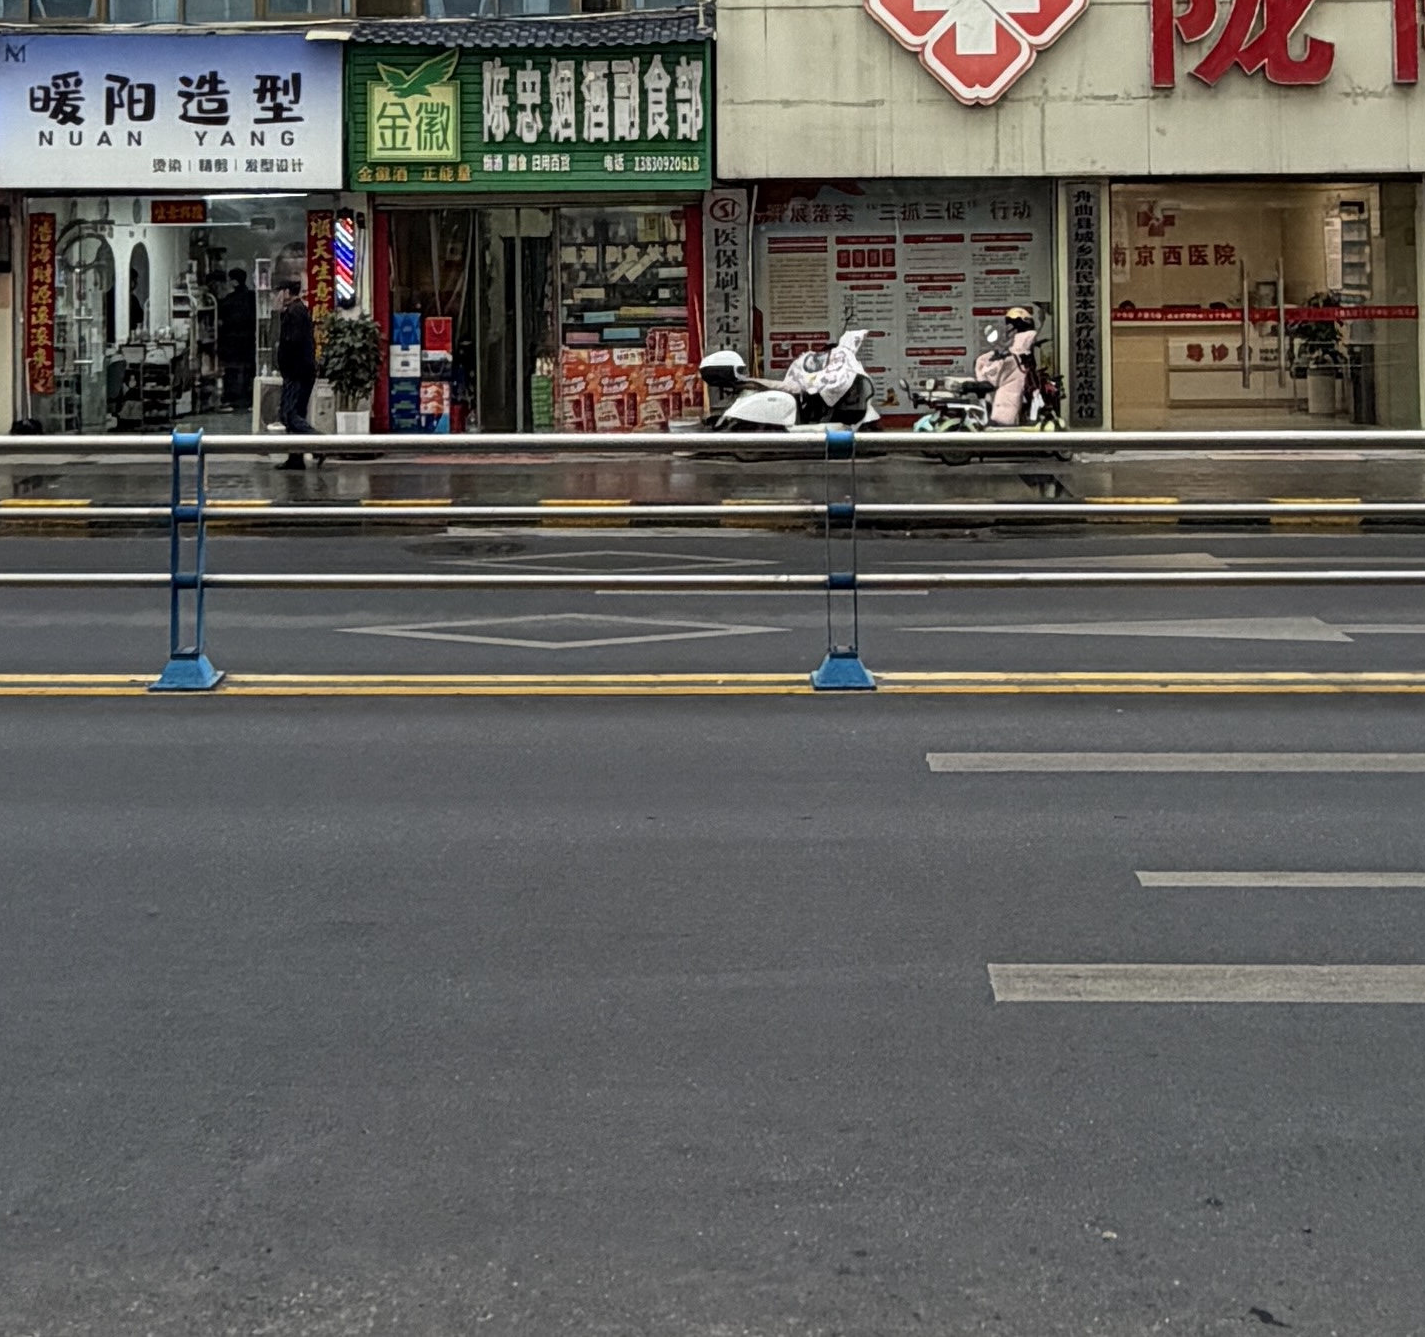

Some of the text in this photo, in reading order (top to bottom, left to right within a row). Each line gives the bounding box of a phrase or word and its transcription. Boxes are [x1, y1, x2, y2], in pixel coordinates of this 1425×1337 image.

[29, 71, 305, 126] 暖阳造型
[38, 131, 296, 147] NUAN YANG
[377, 101, 450, 151] 金徽
[990, 200, 1032, 220] 行动
